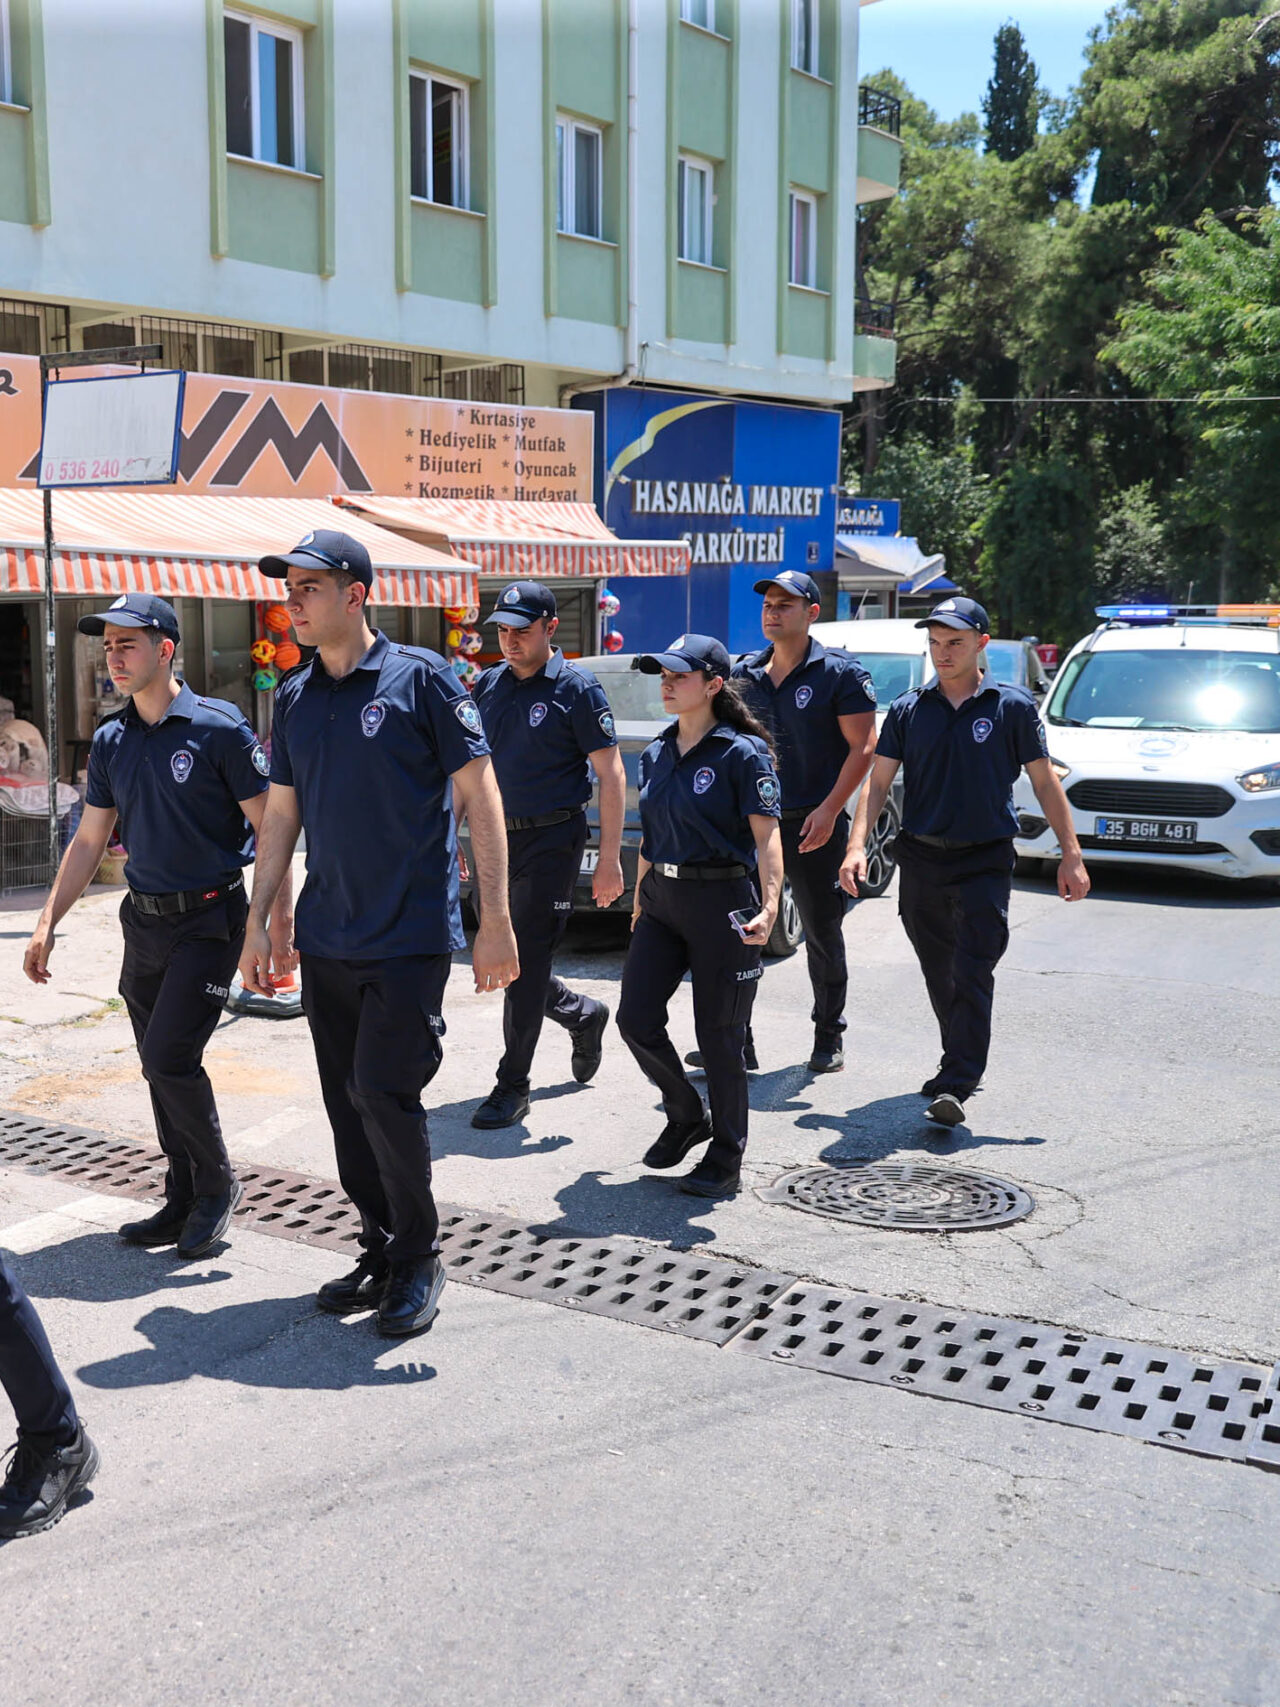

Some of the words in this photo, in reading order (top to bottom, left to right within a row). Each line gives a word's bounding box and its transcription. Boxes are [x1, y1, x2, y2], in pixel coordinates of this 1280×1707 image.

[470, 409, 536, 432] Kırtasiye
[420, 429, 497, 450] Hediyelik
[515, 434, 566, 452] Mutfak
[45, 462, 54, 481] 0
[59, 460, 86, 480] 536
[91, 458, 120, 479] 240
[420, 455, 482, 475] Bijuteri
[514, 460, 577, 480] Oyuncak
[419, 482, 495, 500] Kozmetik
[634, 475, 746, 516] HASANAĞA
[750, 485, 824, 516] MARKET
[1106, 821, 1125, 834] 35
[1131, 822, 1159, 836] BGH
[1165, 825, 1192, 839] 481
